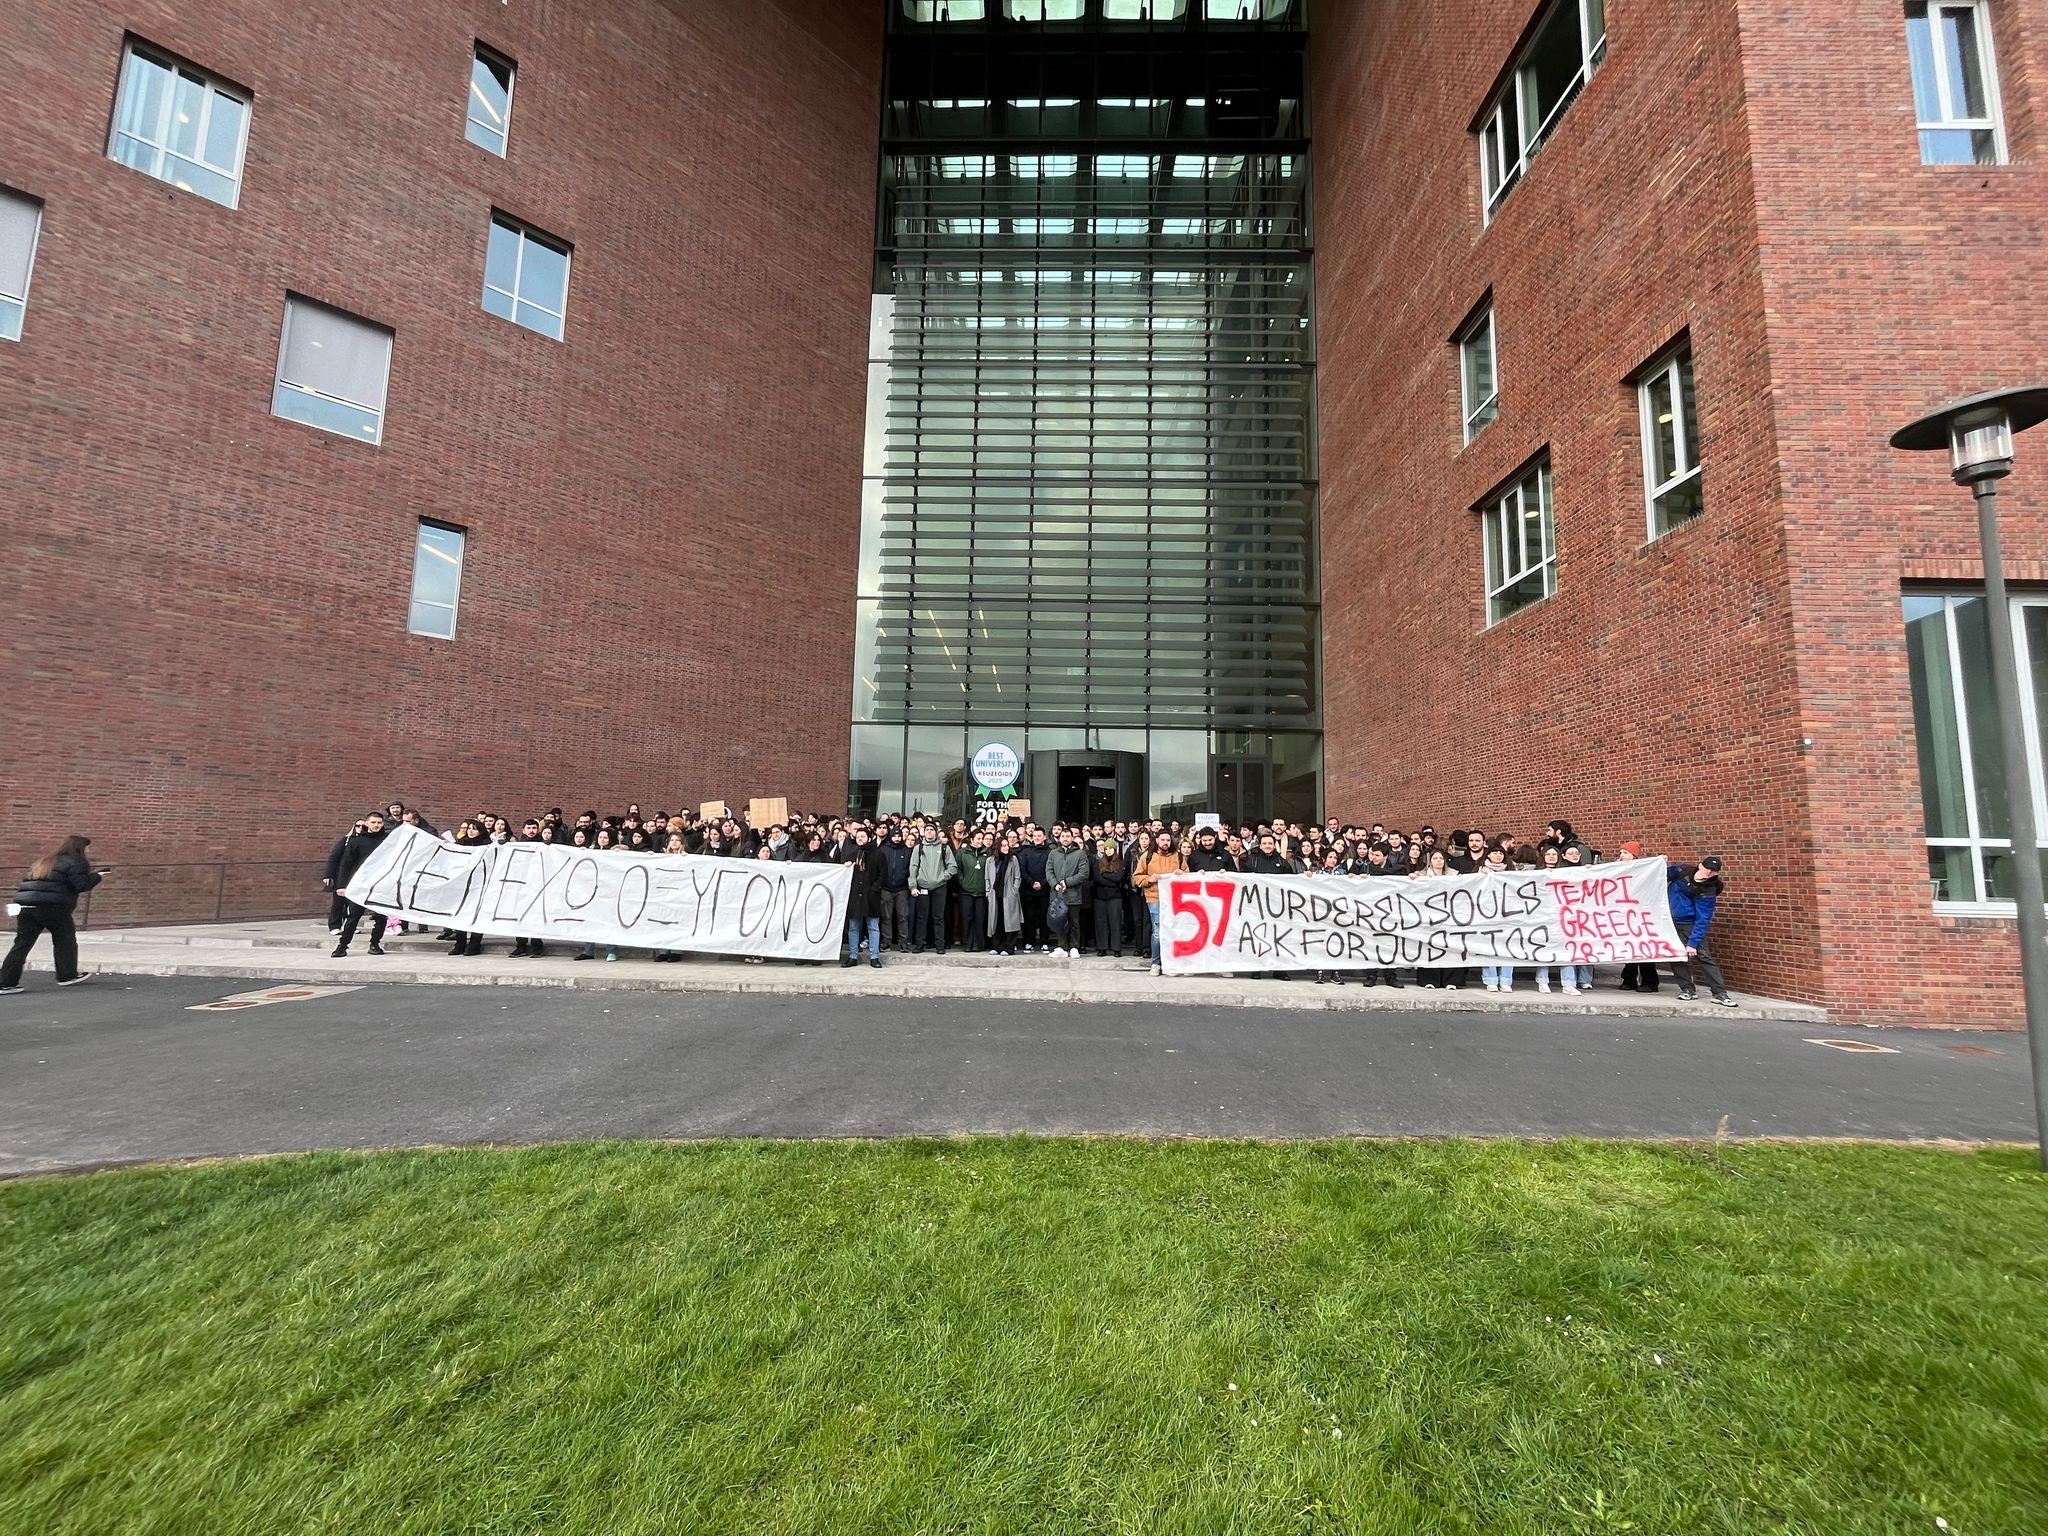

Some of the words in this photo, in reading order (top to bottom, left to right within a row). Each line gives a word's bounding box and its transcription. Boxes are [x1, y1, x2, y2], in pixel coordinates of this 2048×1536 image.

[975, 760, 1016, 768] UNIVERSITY
[988, 752, 1004, 760] BEST
[1238, 884, 1422, 932] MURDERED
[1424, 881, 1541, 926] SOULS
[1545, 875, 1640, 906] TEMPI
[1171, 881, 1235, 957] 57
[1559, 906, 1659, 939] GREECE
[1239, 921, 1296, 957] ASK
[1300, 929, 1369, 961] FOR
[1373, 925, 1556, 965] JUSTICE
